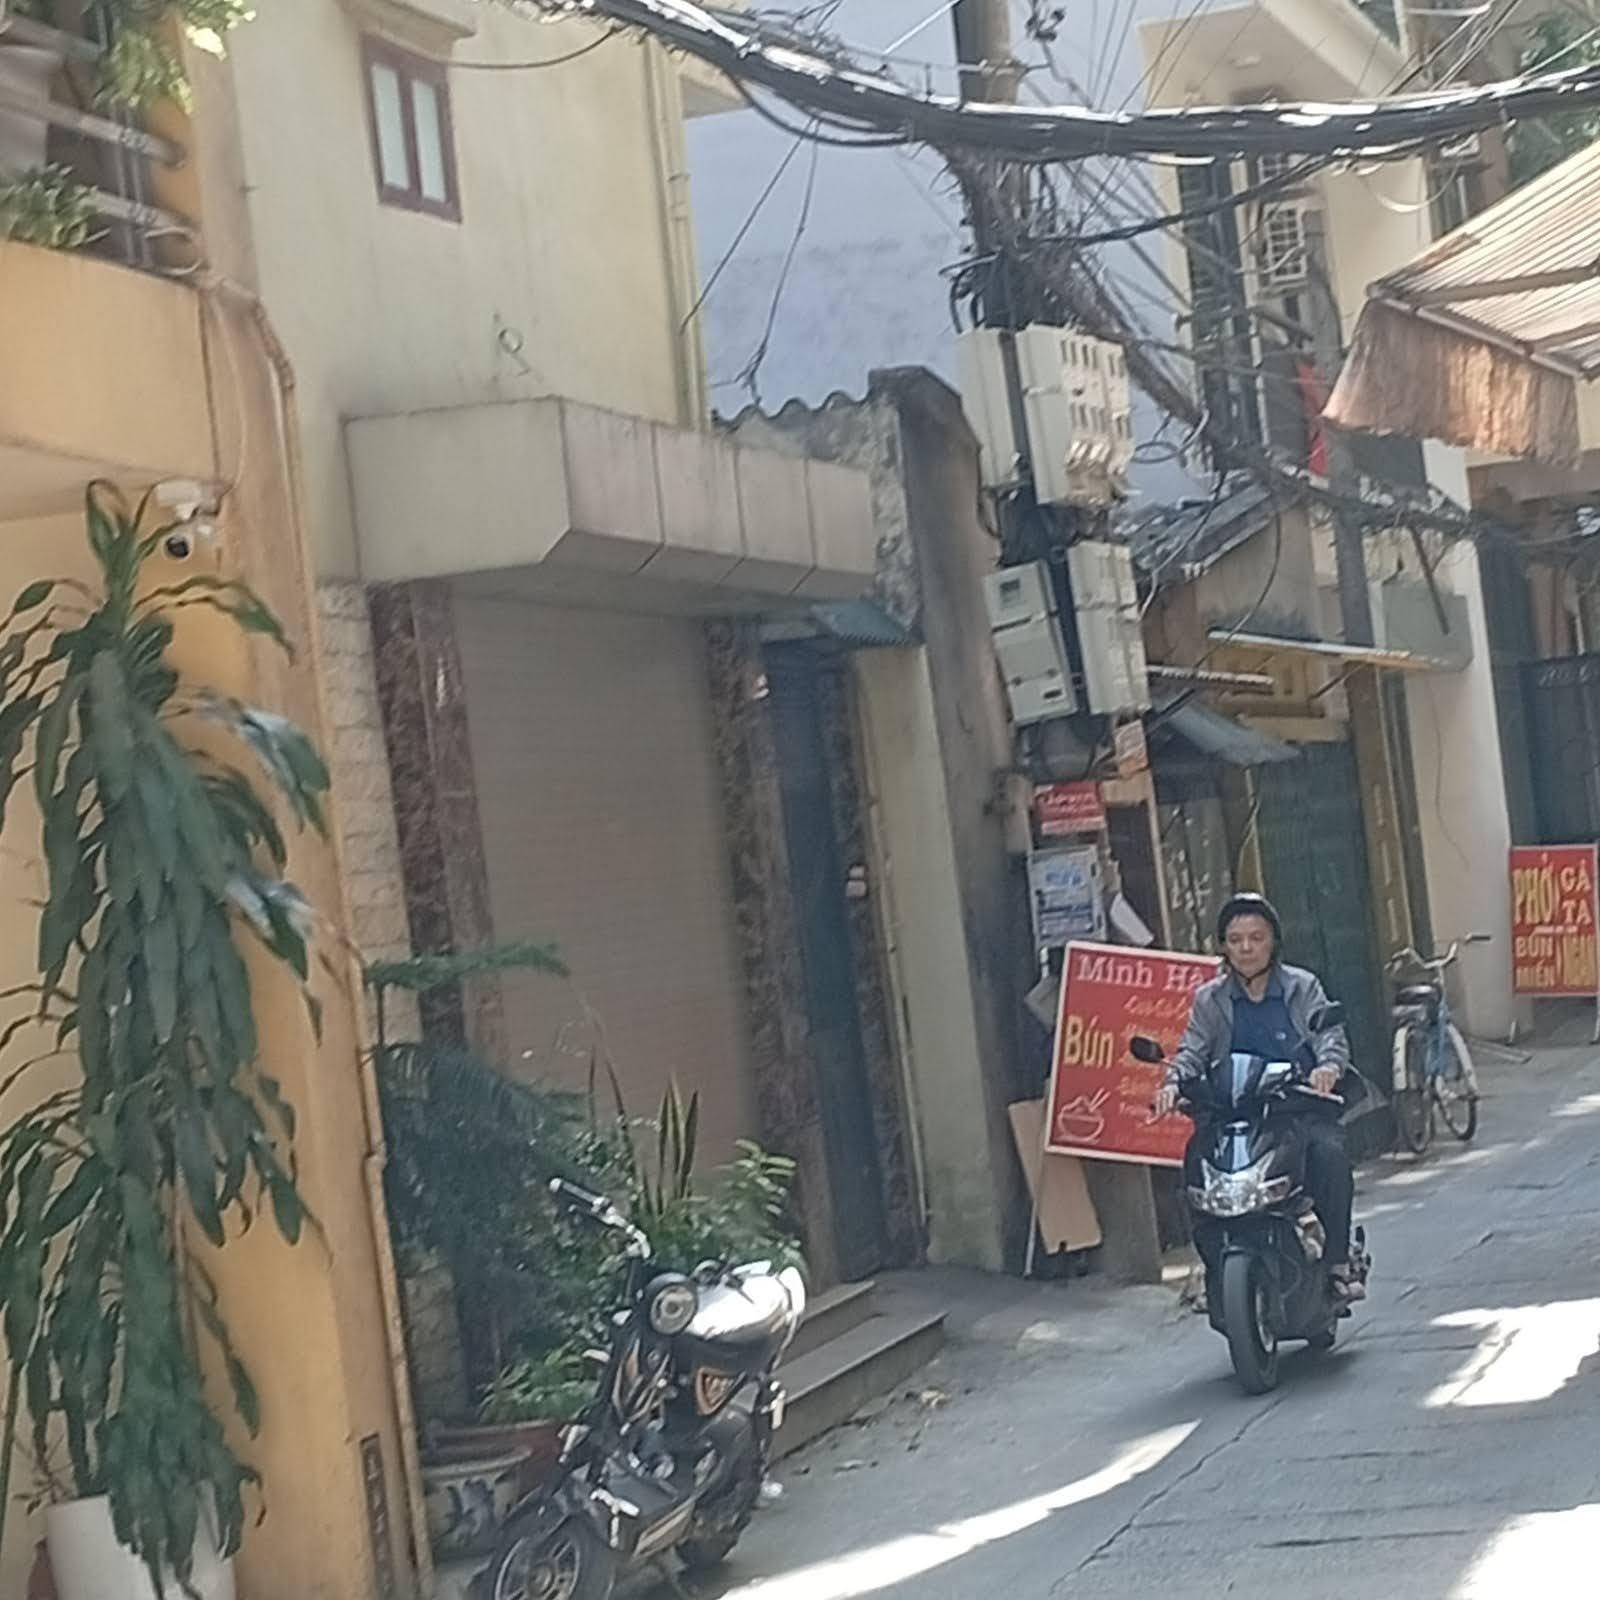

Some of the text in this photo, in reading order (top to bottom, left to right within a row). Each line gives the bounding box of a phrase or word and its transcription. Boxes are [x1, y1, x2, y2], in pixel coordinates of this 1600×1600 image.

[1561, 899, 1593, 926] TA
[1077, 954, 1153, 989] Minh
[1063, 1015, 1114, 1070] Bún
